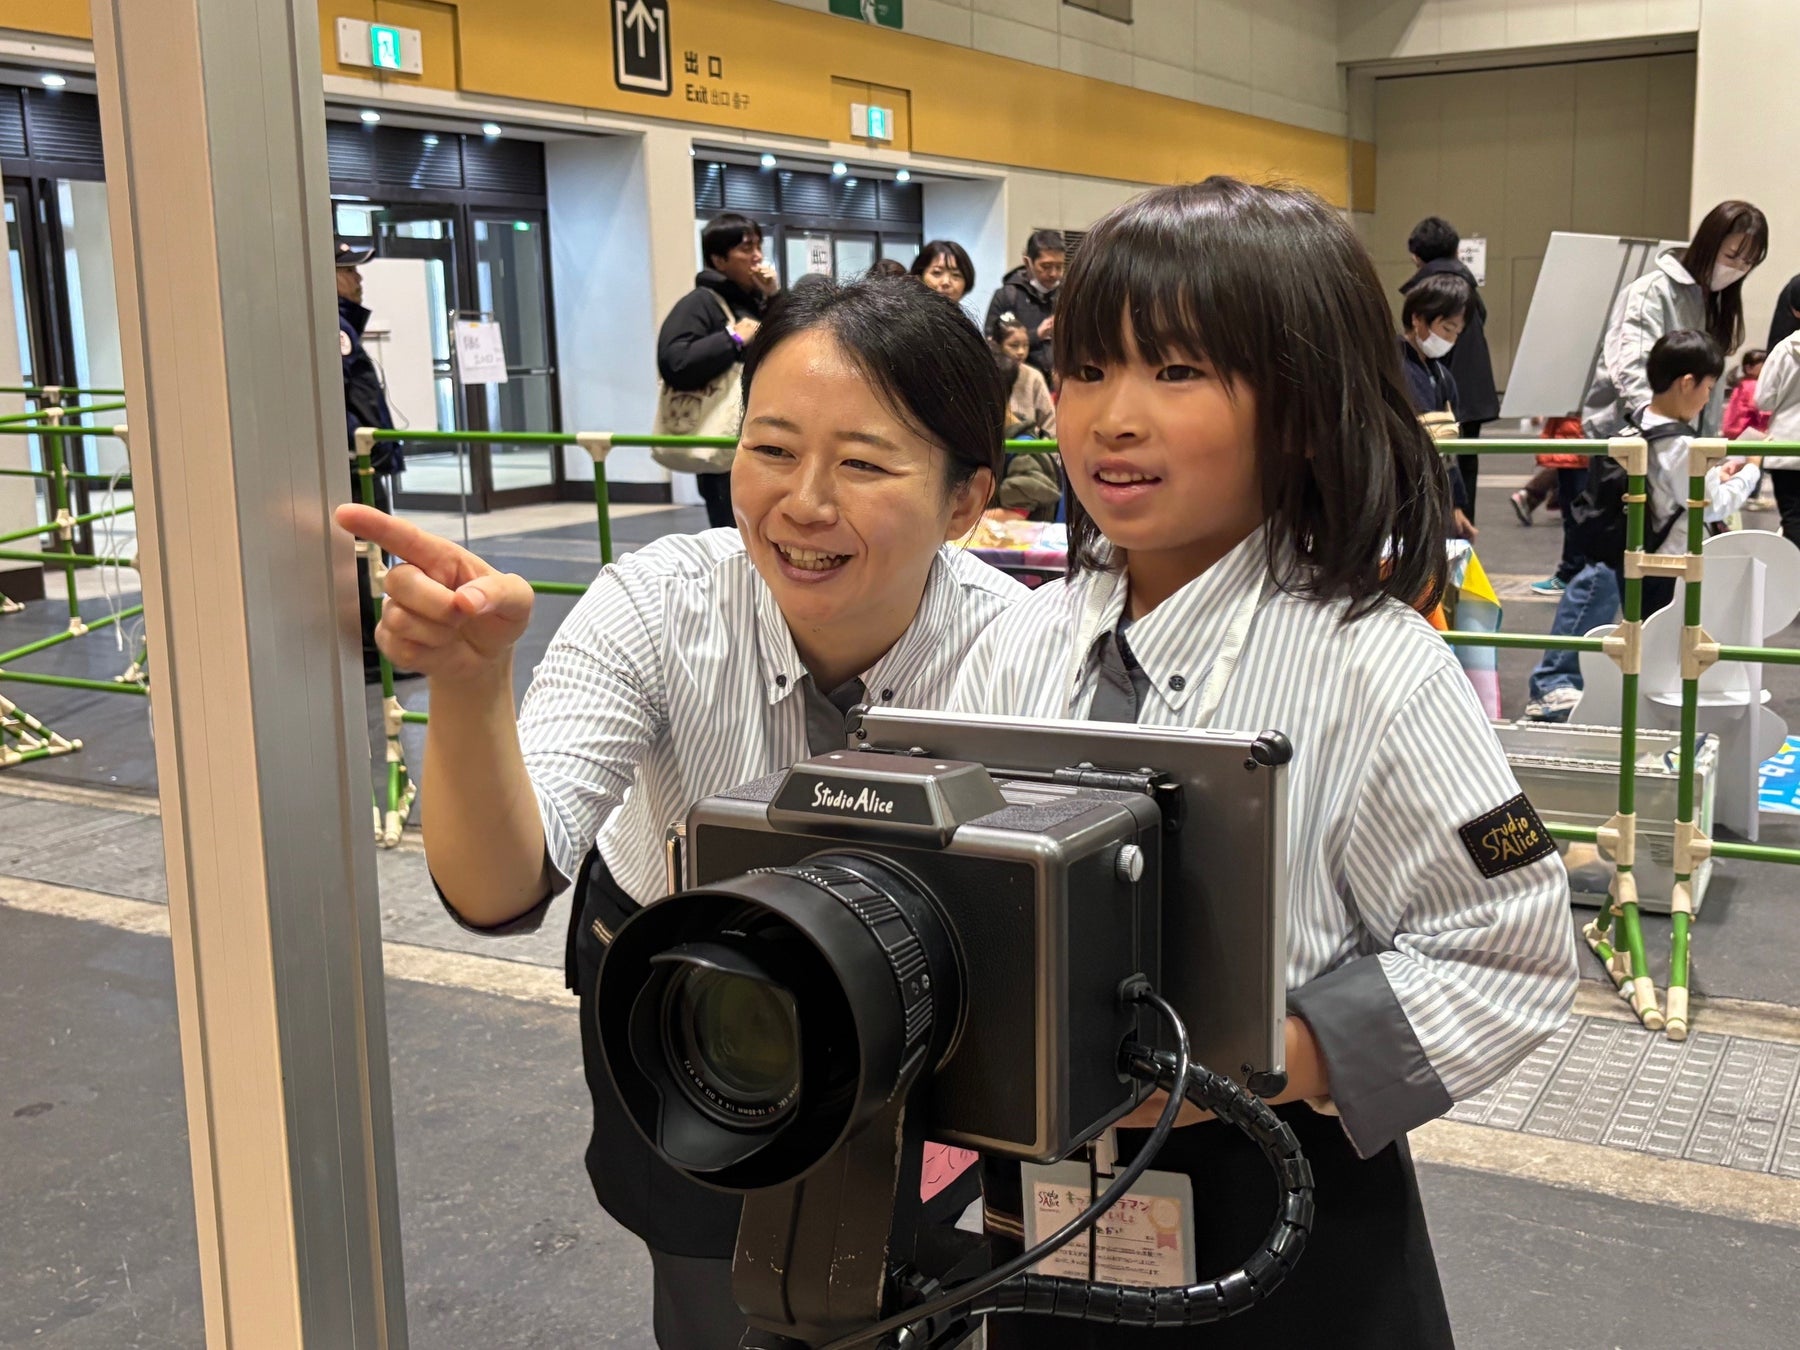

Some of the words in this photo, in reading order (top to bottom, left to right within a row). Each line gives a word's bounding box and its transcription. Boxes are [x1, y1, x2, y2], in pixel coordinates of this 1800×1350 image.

[684, 51, 722, 79] 出口
[685, 84, 708, 104] Exit
[811, 781, 854, 809] Studio
[853, 787, 894, 814] Alice
[1482, 812, 1528, 860] Studio
[1501, 830, 1539, 860] Alice
